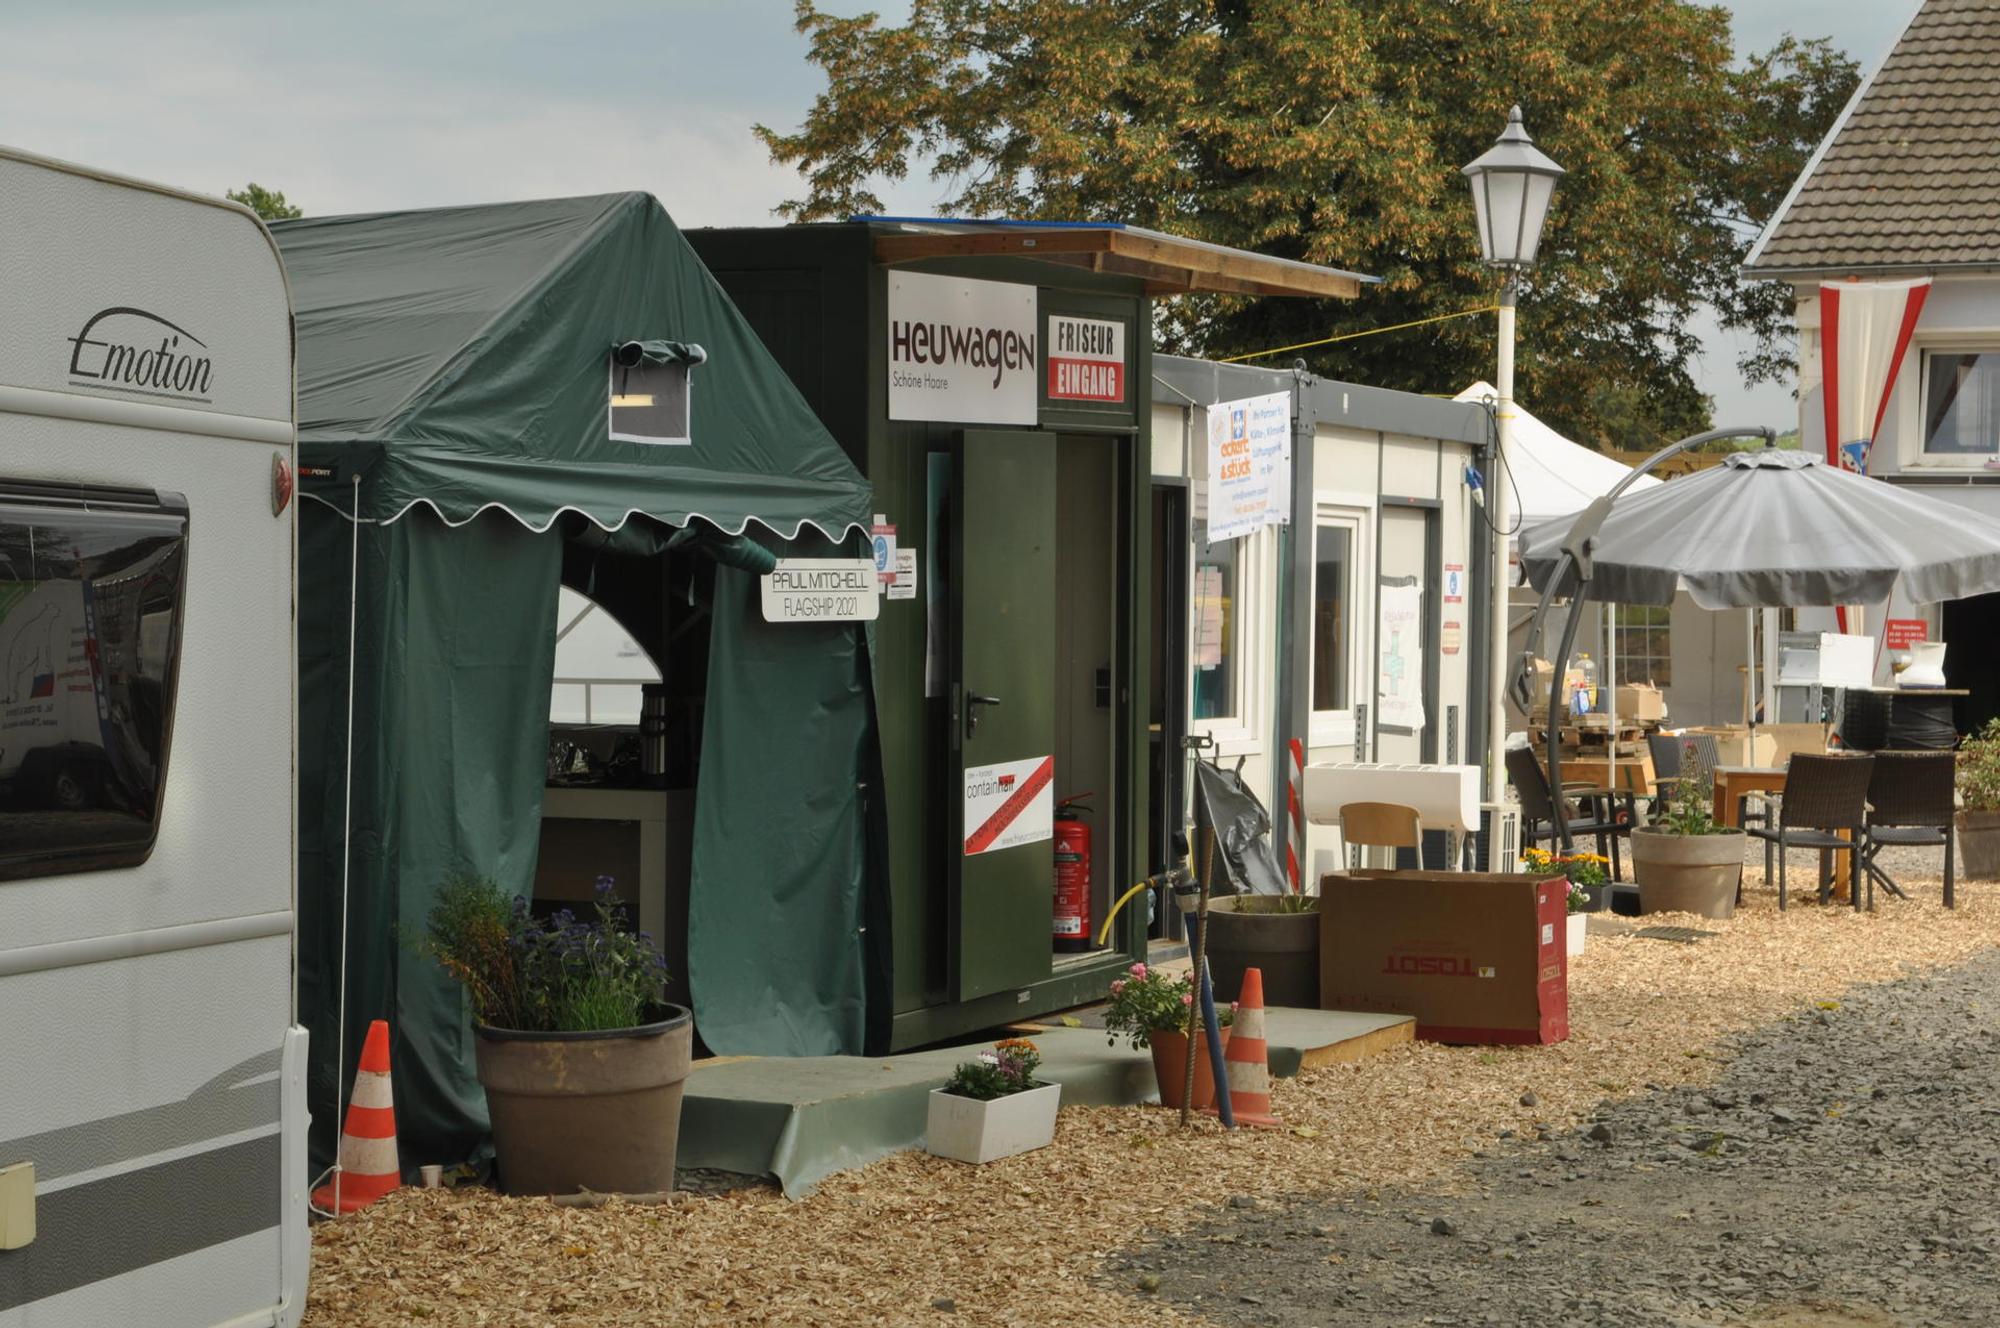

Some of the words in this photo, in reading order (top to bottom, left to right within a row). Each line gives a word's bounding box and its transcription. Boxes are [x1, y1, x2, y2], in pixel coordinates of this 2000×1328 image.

[67, 307, 214, 394] Emotion
[1058, 321, 1114, 355] FRISEUR
[893, 370, 922, 389] Schöne
[924, 373, 949, 390] Haare
[1057, 362, 1116, 397] EINGANG
[772, 572, 807, 589] PAUL
[808, 571, 868, 589] MITCHELL
[784, 597, 834, 617] FLAGSHIP
[836, 596, 858, 616] 2021
